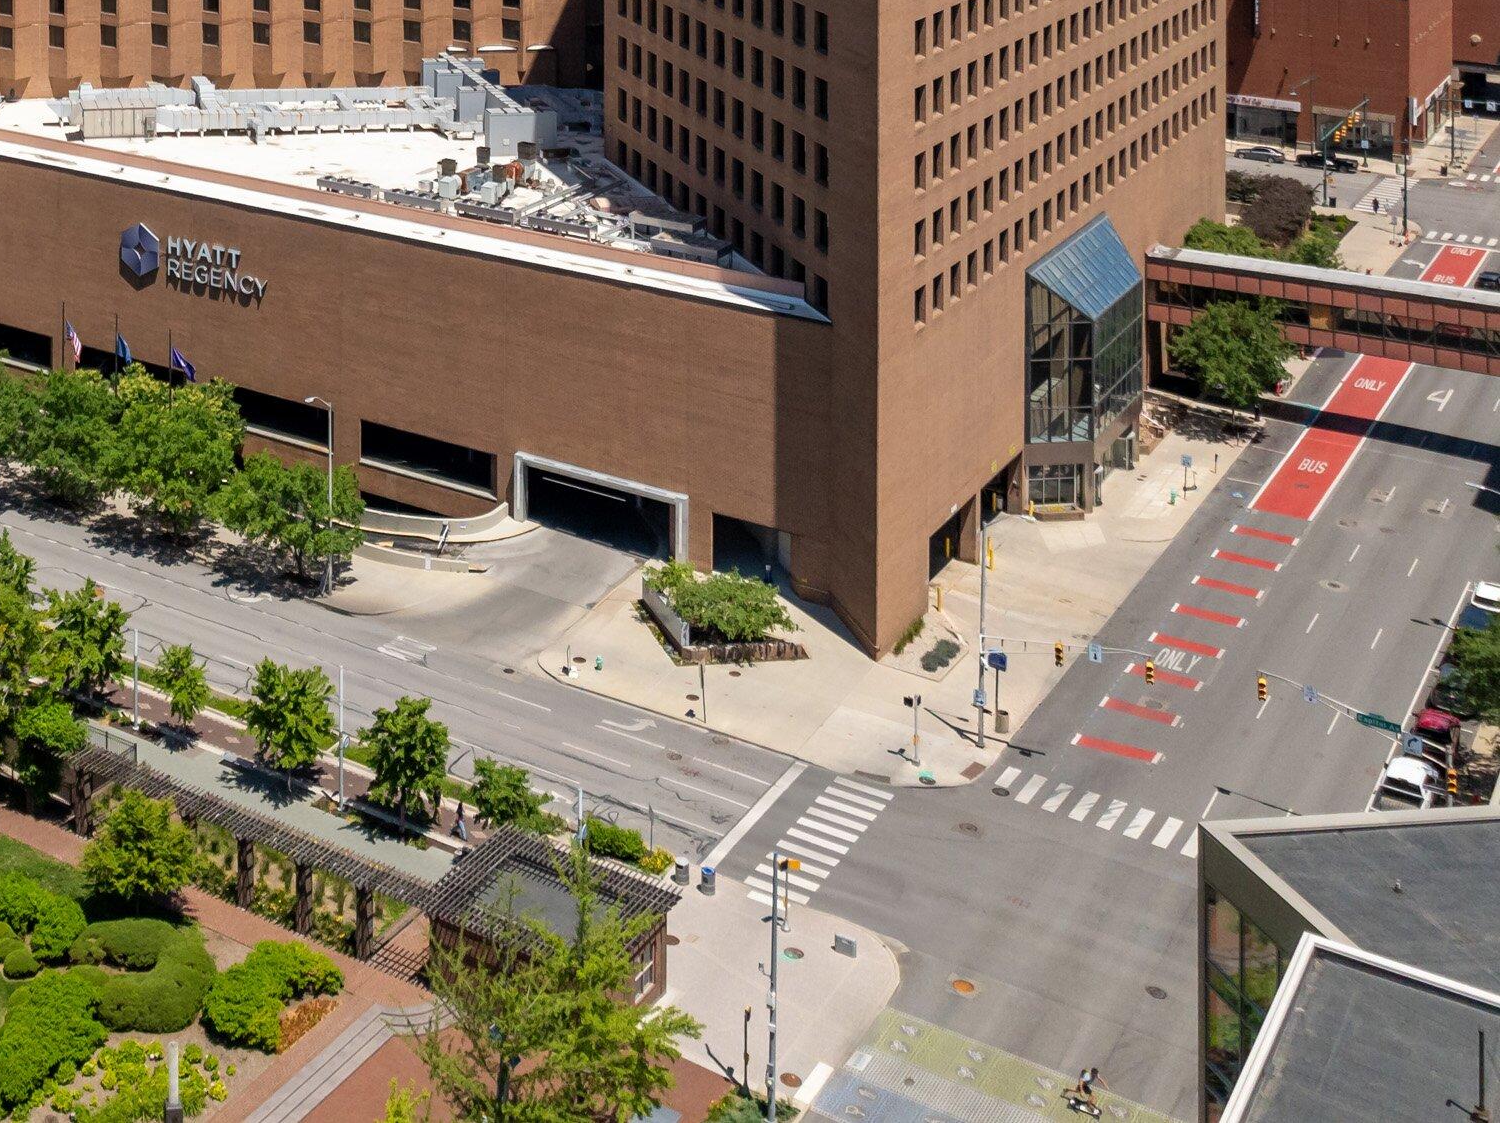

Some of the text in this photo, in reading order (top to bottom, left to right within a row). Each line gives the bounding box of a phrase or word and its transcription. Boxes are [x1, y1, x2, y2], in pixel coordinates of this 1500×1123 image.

[167, 235, 242, 269] HYATT
[1450, 247, 1476, 257] ONLY
[167, 258, 268, 298] REGENCY
[1432, 274, 1456, 284] BUS
[1353, 377, 1387, 392] ONLY
[1297, 458, 1329, 474] BUS
[1153, 647, 1203, 674] ONLY
